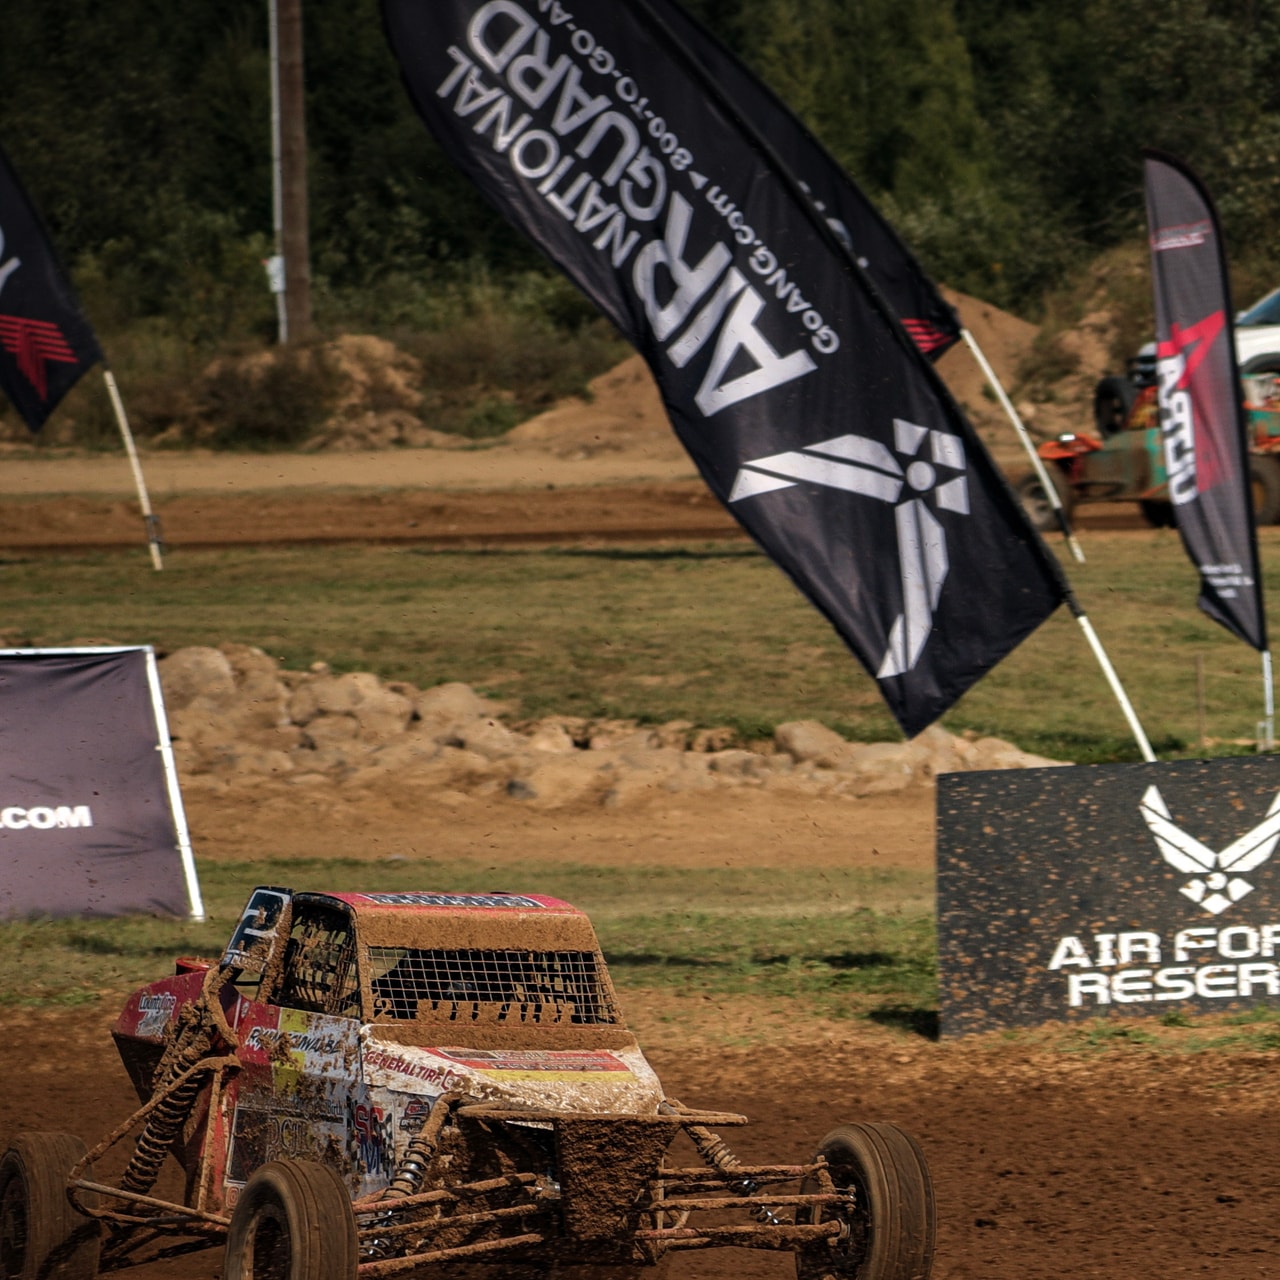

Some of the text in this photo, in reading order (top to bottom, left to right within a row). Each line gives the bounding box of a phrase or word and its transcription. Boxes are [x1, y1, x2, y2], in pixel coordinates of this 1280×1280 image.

[436, 45, 641, 268] NATIONAL
[467, 0, 667, 221] GUARD
[632, 191, 818, 417] AIR
[1047, 931, 1162, 971] AIR
